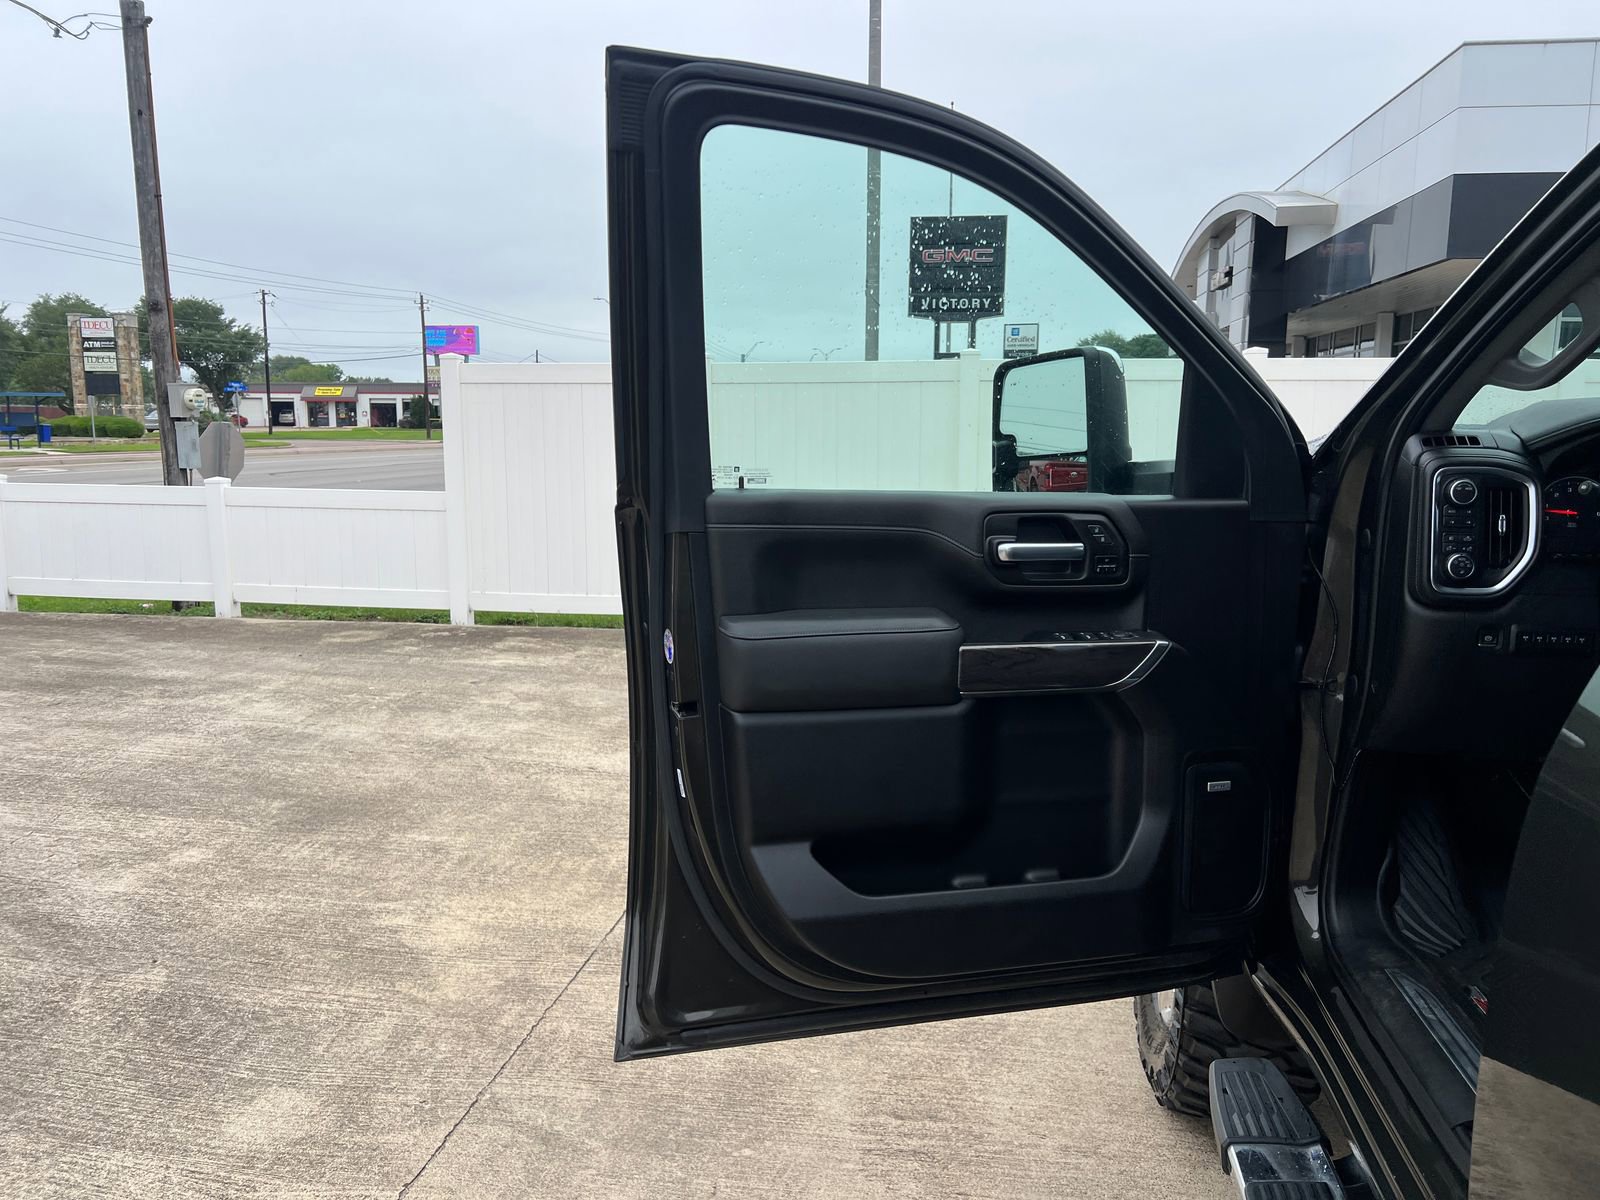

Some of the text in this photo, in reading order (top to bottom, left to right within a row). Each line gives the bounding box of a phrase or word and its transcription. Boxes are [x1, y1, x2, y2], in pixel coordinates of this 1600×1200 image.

[922, 248, 994, 263] GMC
[921, 297, 992, 309] VICTORY
[83, 320, 112, 329] TDECU
[86, 355, 115, 364] TDECU
